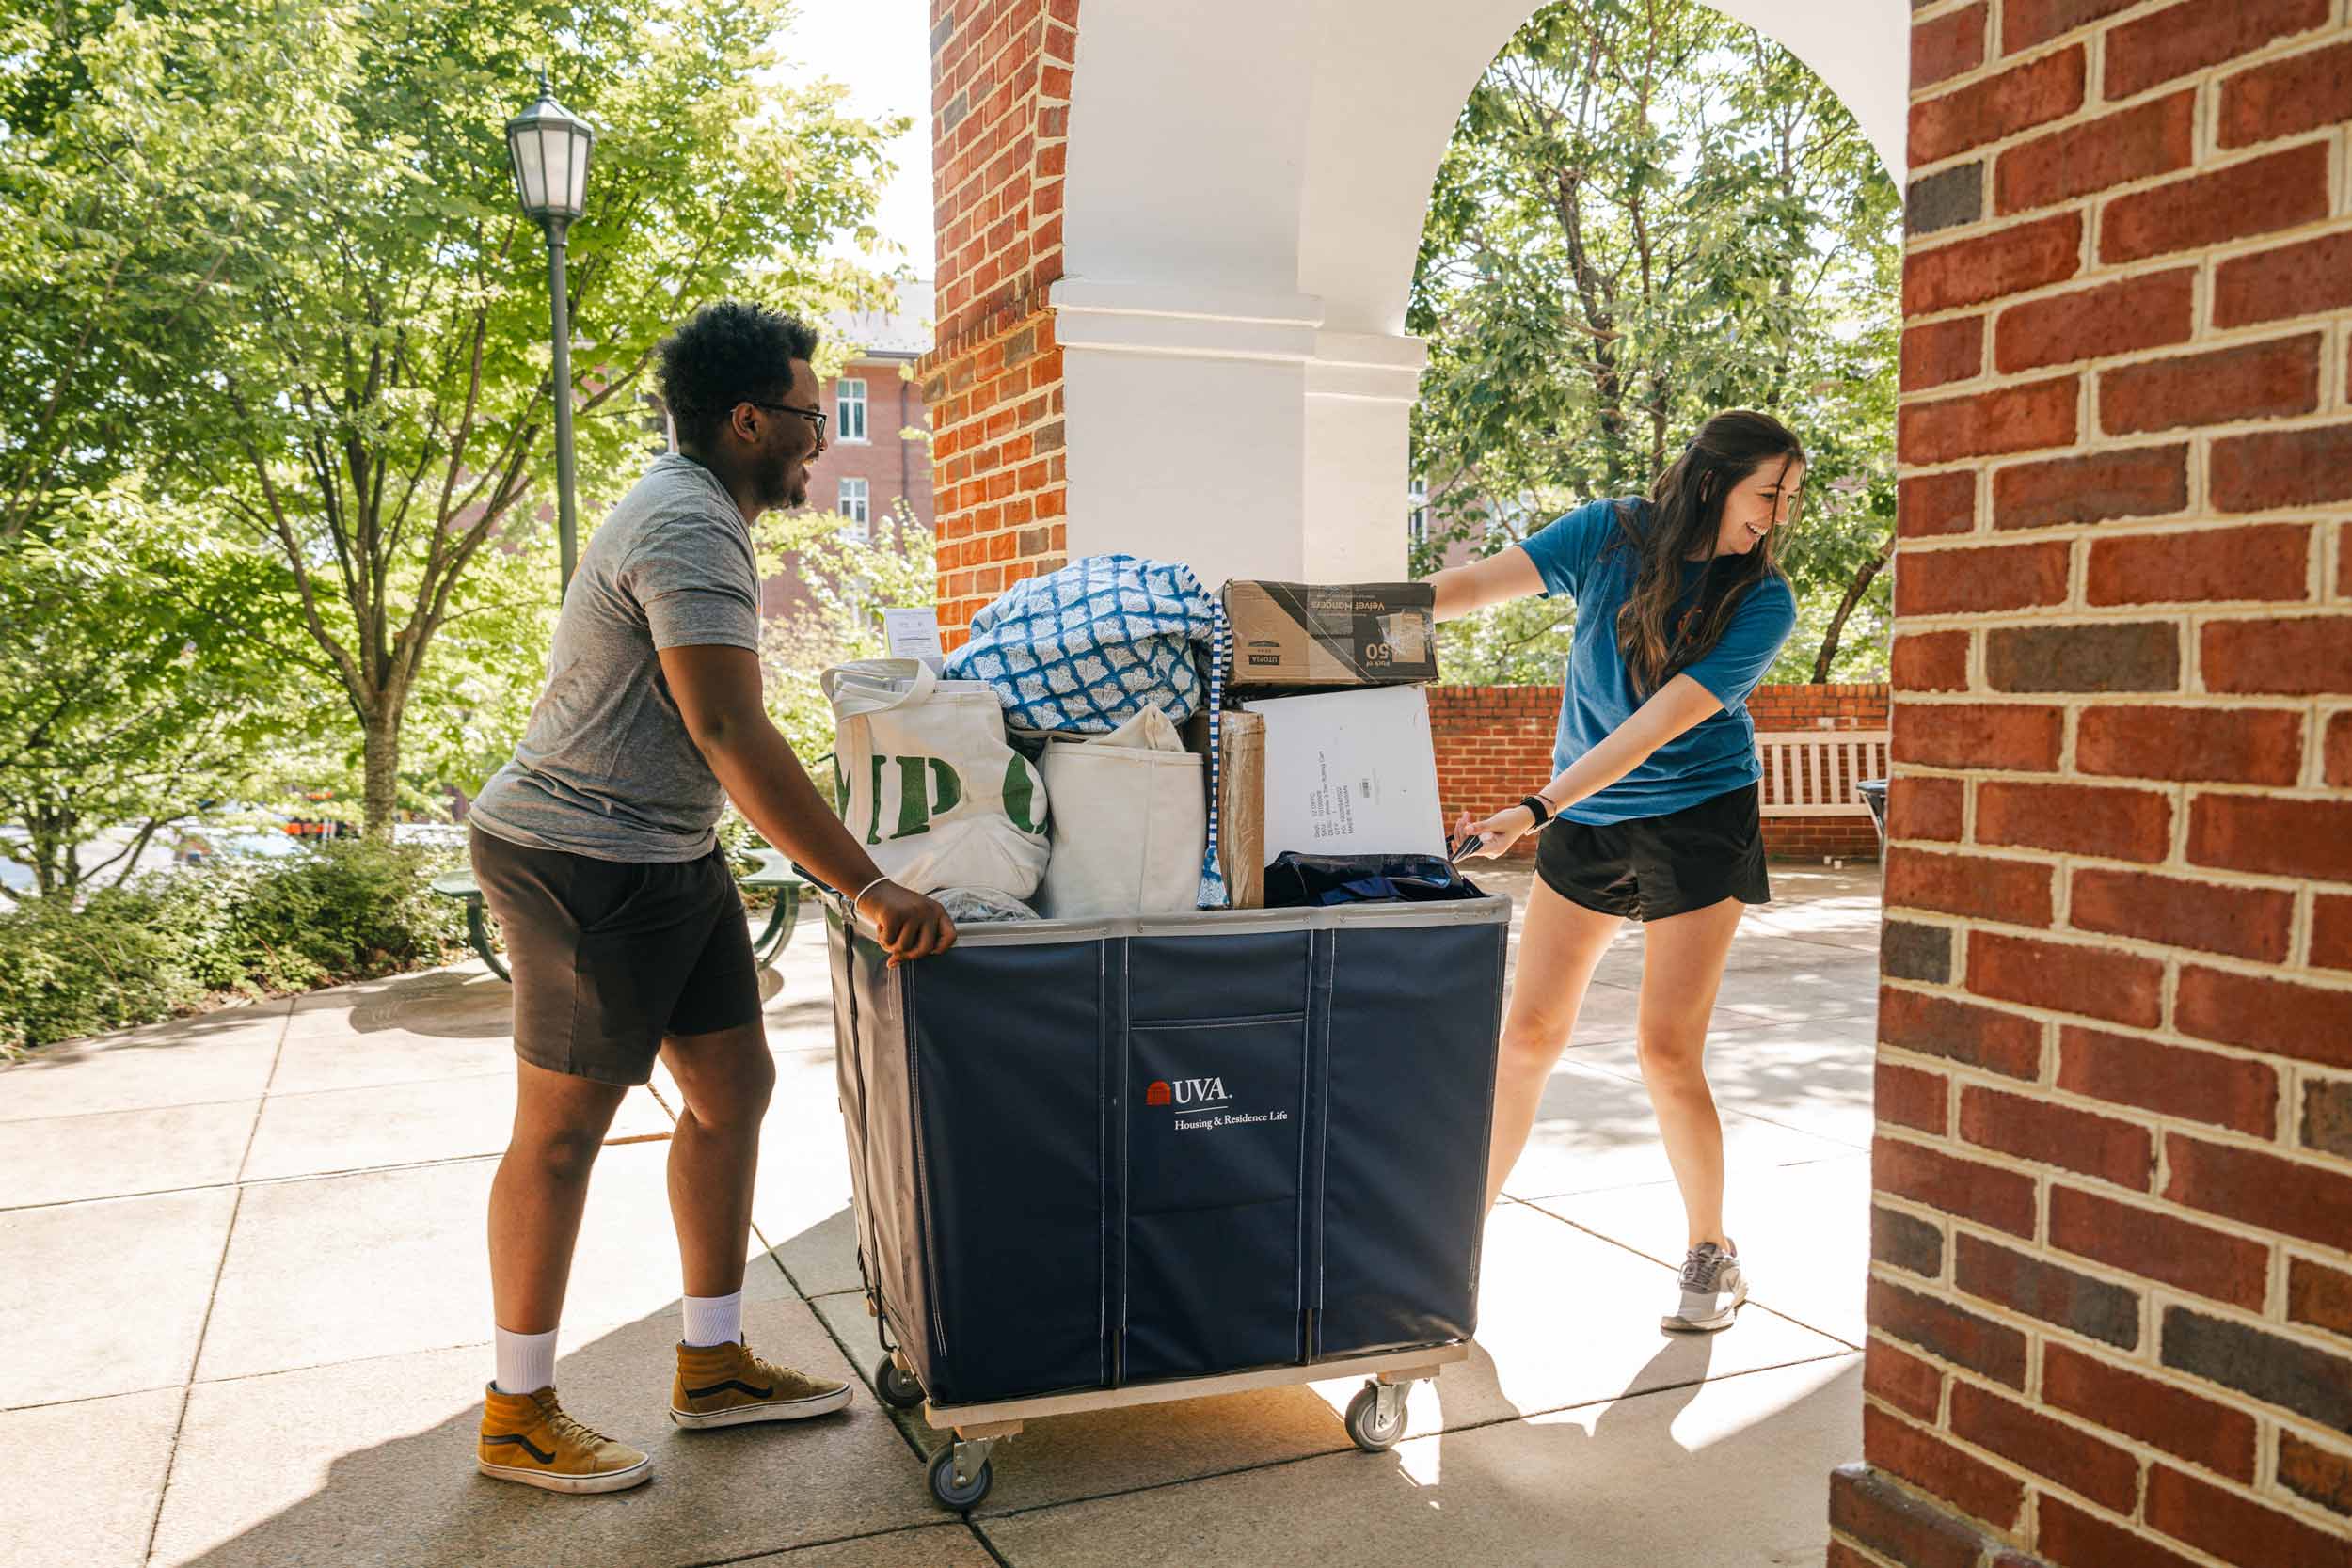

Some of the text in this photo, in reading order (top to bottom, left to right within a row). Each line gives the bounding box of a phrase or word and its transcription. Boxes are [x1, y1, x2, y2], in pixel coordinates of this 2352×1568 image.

[1310, 599, 1385, 611] Velvet Hangers
[1366, 643, 1389, 659] 50
[1175, 1110, 1288, 1130] Housing & Residence Life
